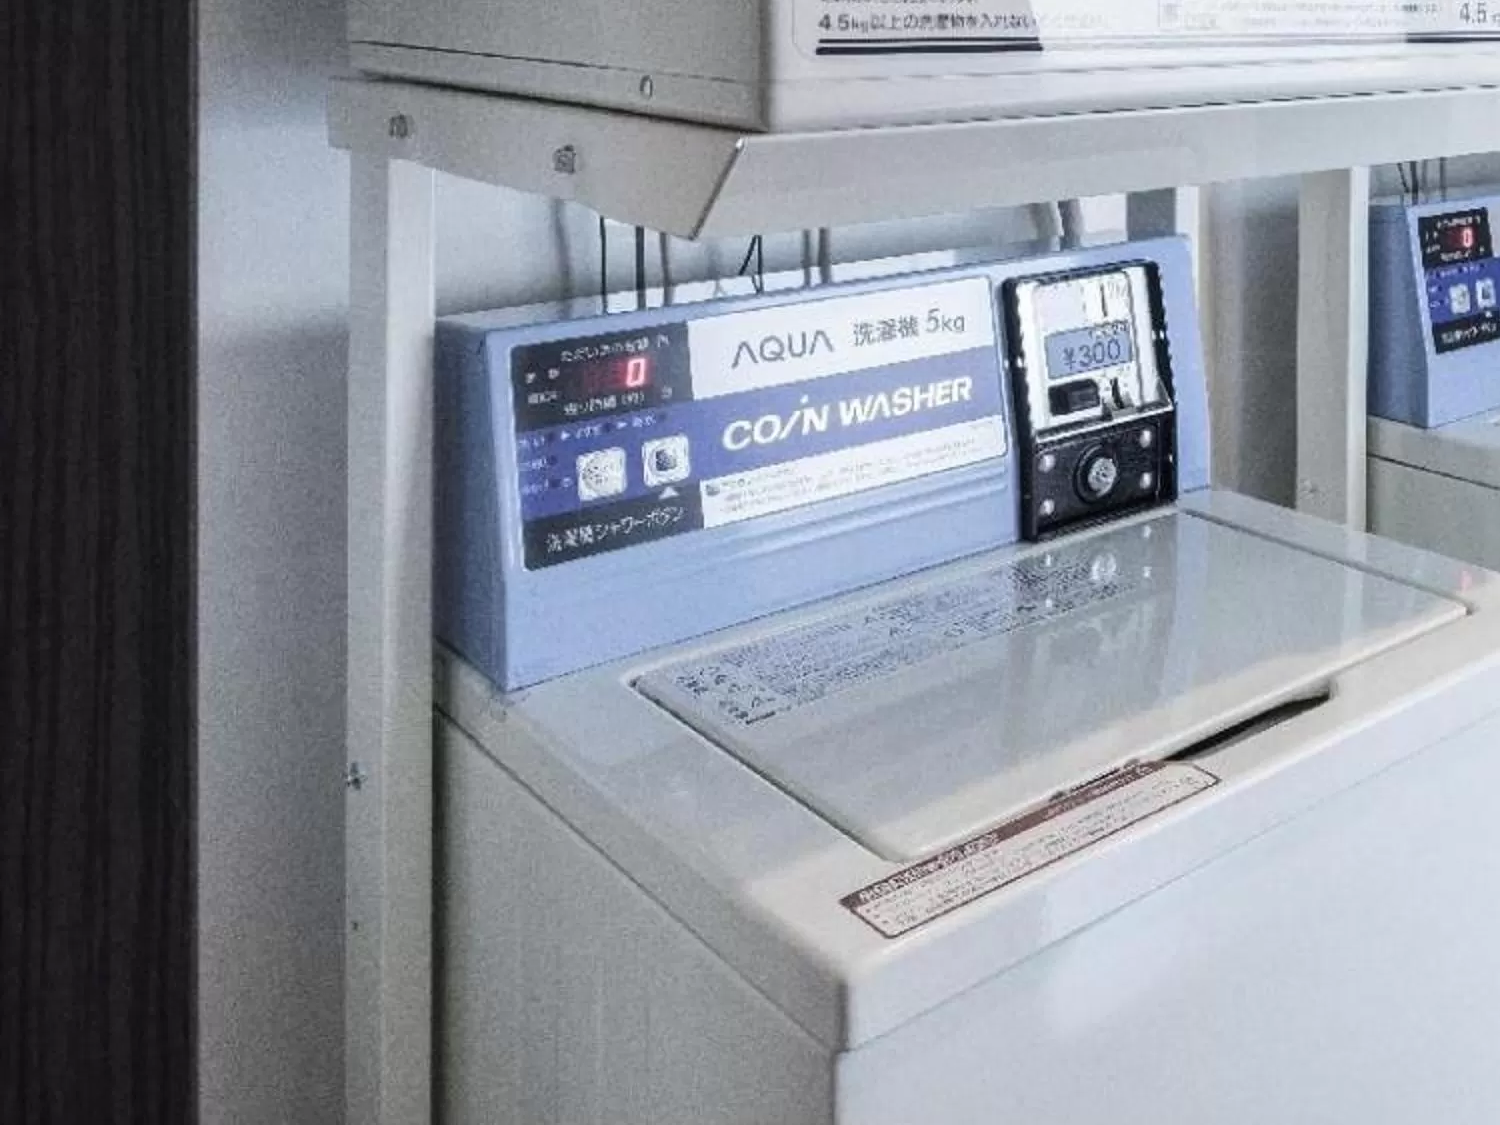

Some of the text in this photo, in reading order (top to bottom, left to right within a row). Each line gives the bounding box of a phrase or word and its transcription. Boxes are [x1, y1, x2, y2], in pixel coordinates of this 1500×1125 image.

[732, 308, 966, 370] AQUA 洗濯機 5kg
[1063, 337, 1122, 370] ¥300
[625, 357, 646, 388] 0
[722, 376, 973, 452] COIN WASHER
